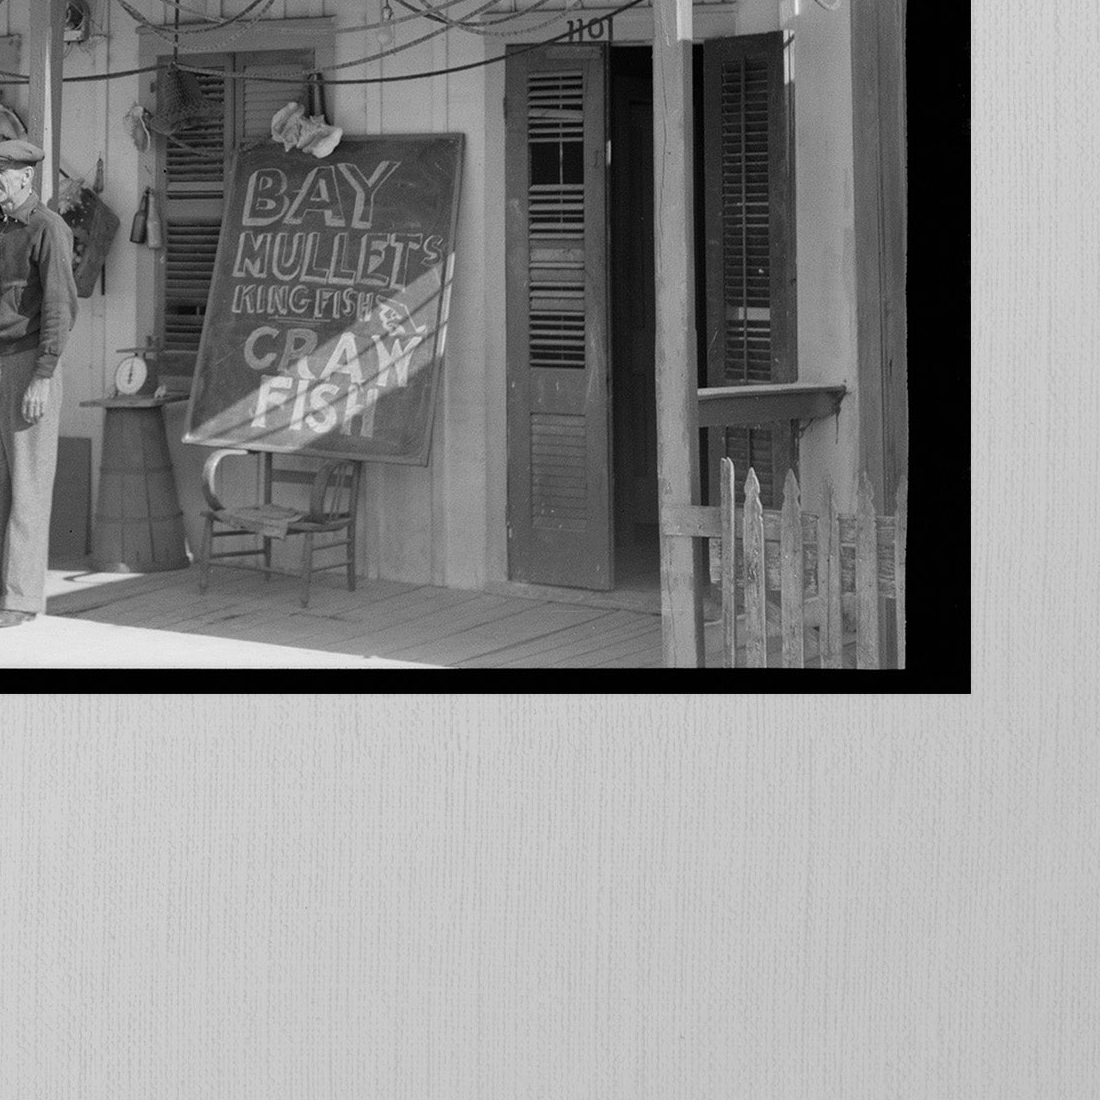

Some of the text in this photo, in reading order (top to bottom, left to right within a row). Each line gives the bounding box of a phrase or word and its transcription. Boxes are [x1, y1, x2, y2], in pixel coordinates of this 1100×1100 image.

[241, 159, 402, 230] BAY
[231, 230, 445, 293] MULLETS
[243, 325, 424, 388] CRAW
[250, 373, 381, 440] FISH
